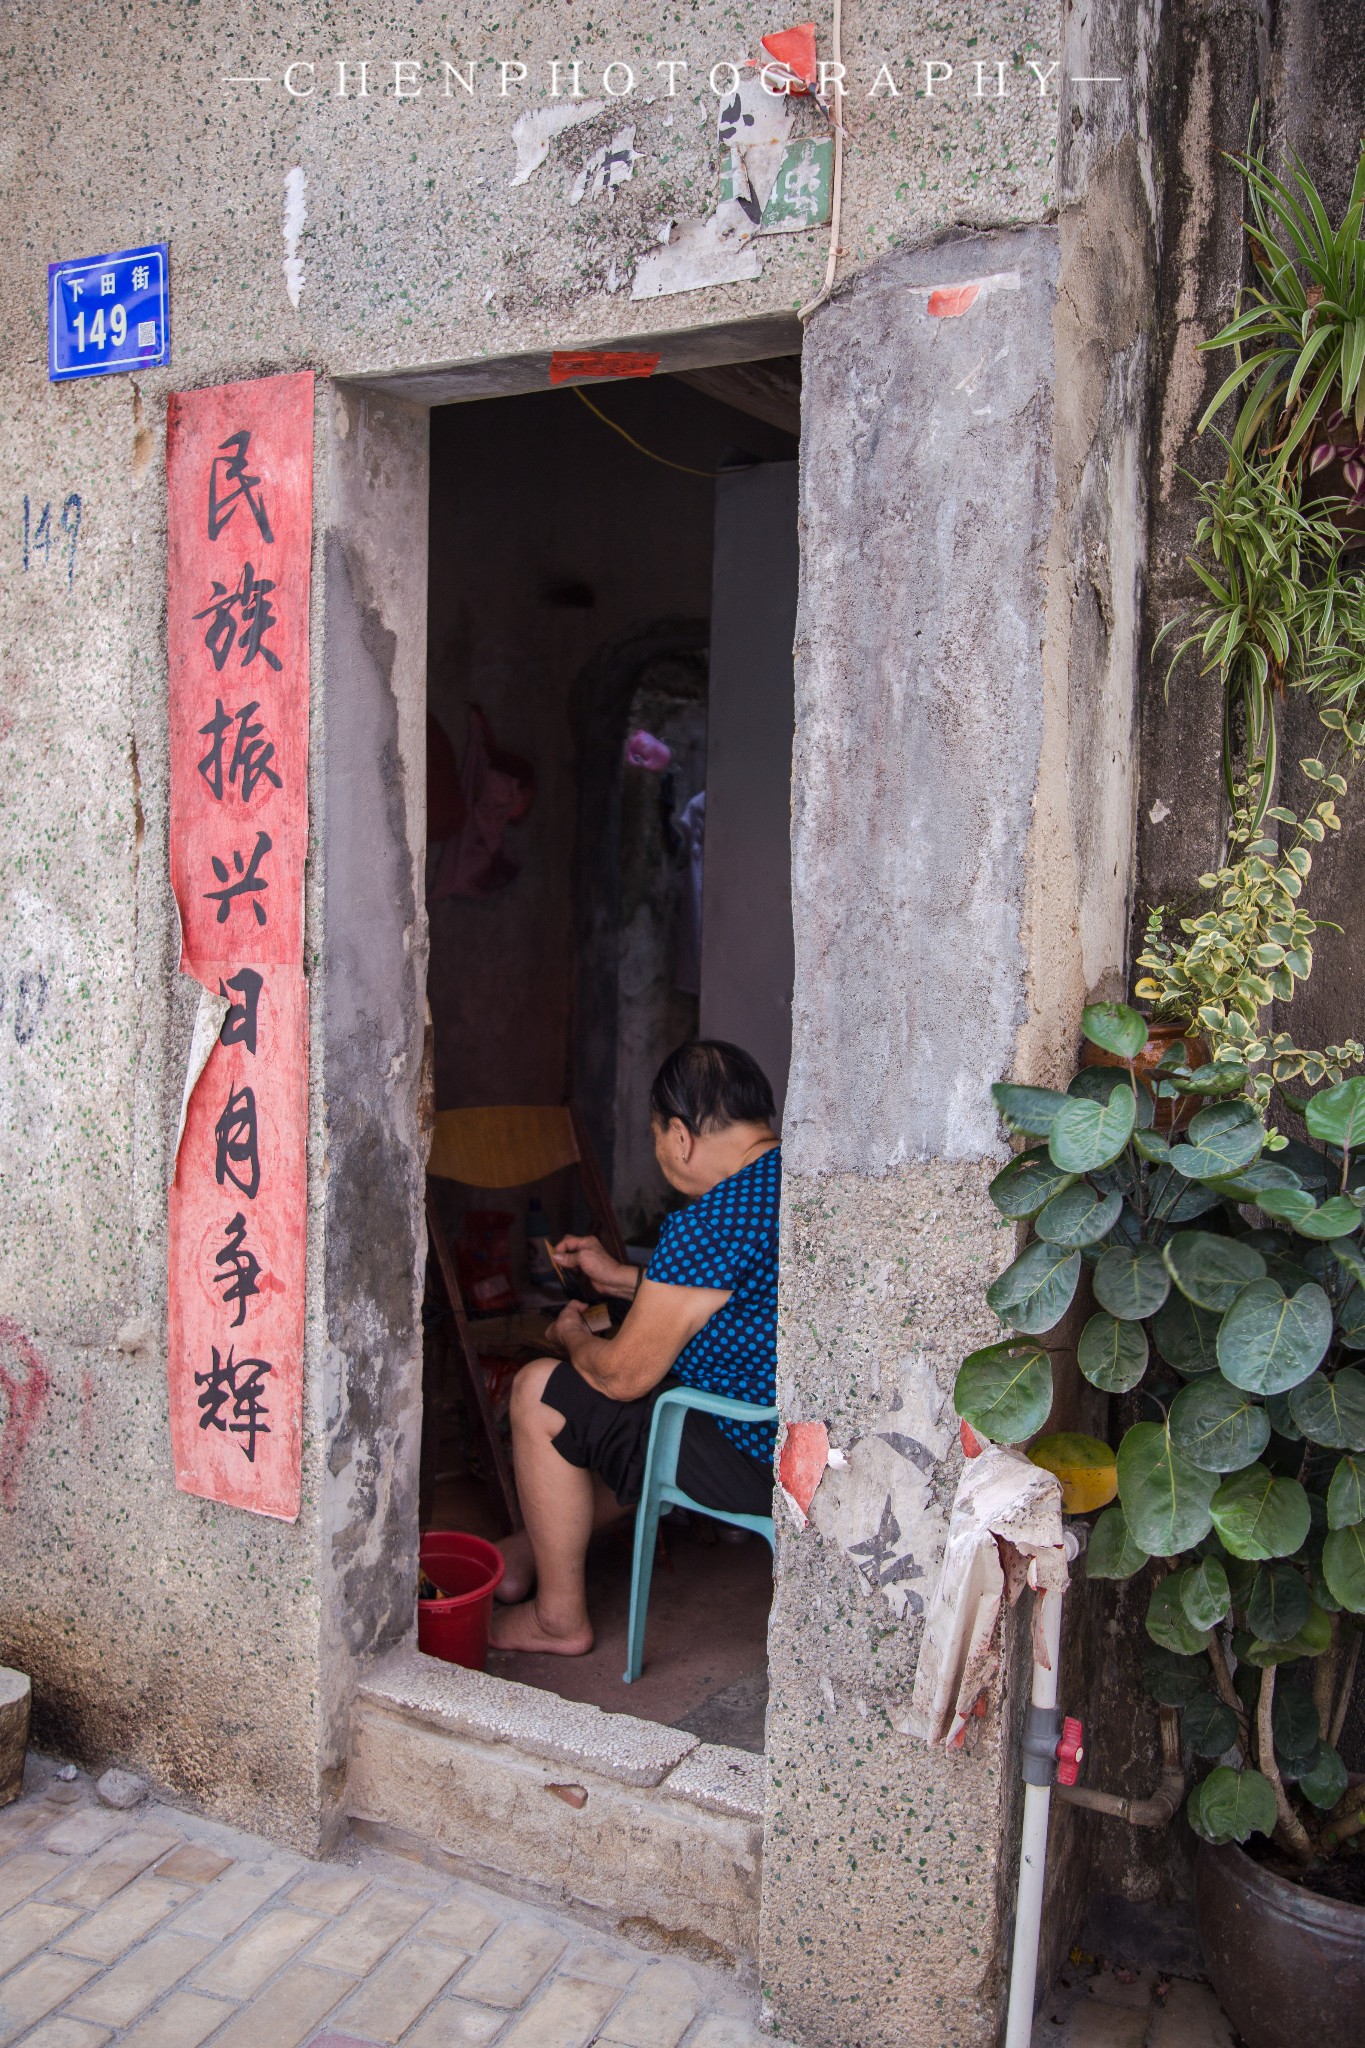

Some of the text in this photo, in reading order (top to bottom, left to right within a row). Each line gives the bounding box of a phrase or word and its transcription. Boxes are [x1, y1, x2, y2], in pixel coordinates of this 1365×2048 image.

[68, 265, 149, 303] 下田街
[73, 303, 127, 353] 149
[23, 493, 82, 592] 149
[192, 430, 283, 1463] 民族振兴日月争辉
